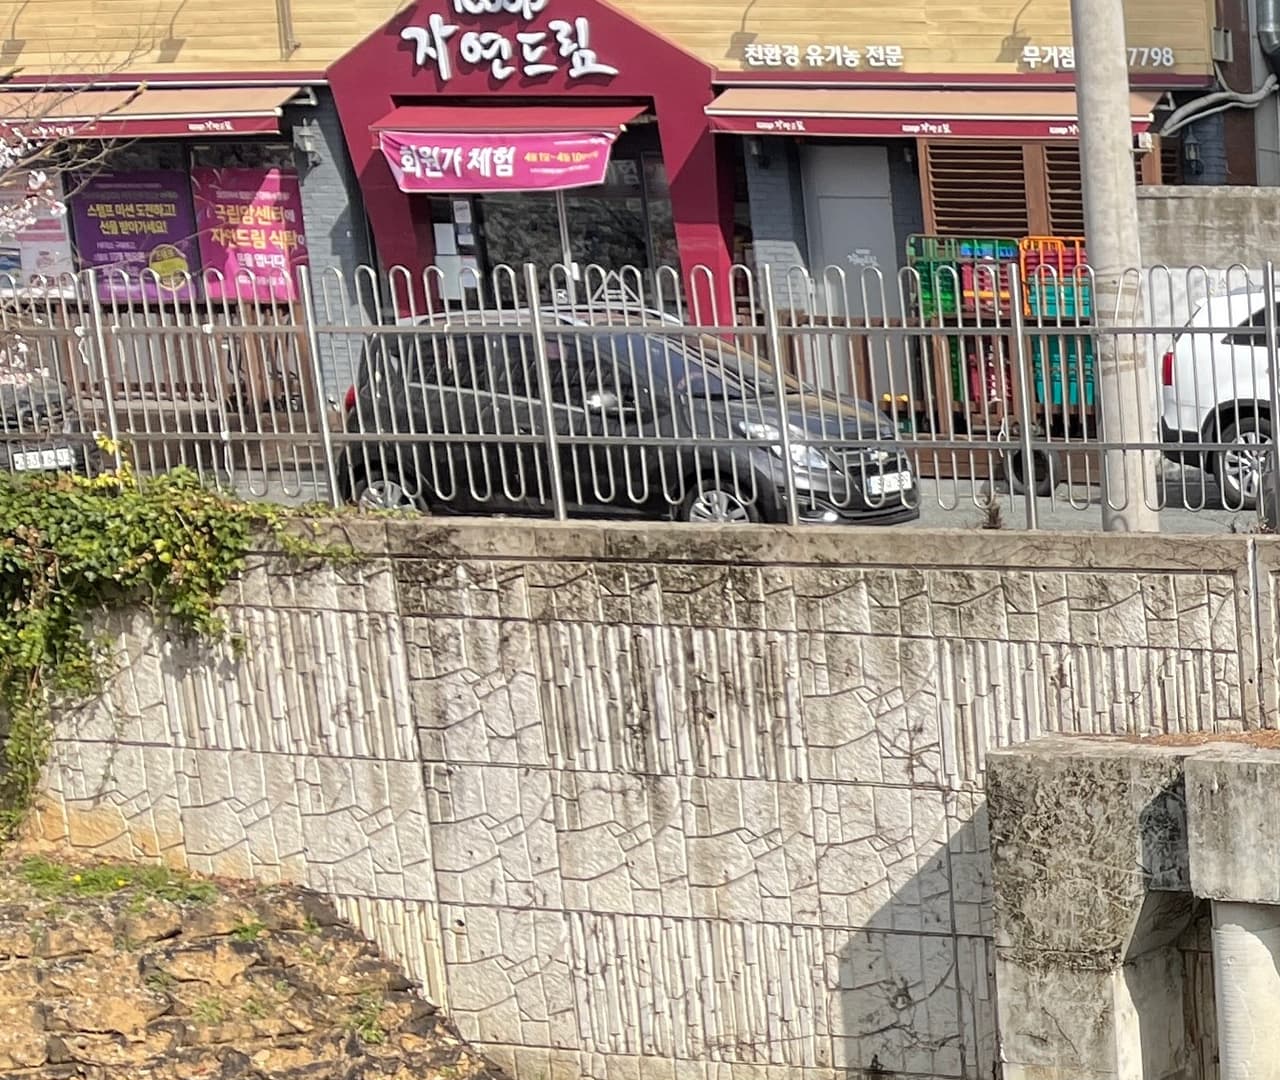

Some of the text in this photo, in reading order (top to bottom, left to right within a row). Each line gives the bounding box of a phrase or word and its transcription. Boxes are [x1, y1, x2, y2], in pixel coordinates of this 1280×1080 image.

[400, 13, 619, 80] 자연드림
[744, 45, 800, 67] 친환경
[805, 45, 860, 67] 유기농
[865, 45, 904, 68] 전문
[1022, 46, 1076, 68] 무거점
[400, 144, 516, 178] 회원가 체험
[211, 228, 267, 250] 자연드림
